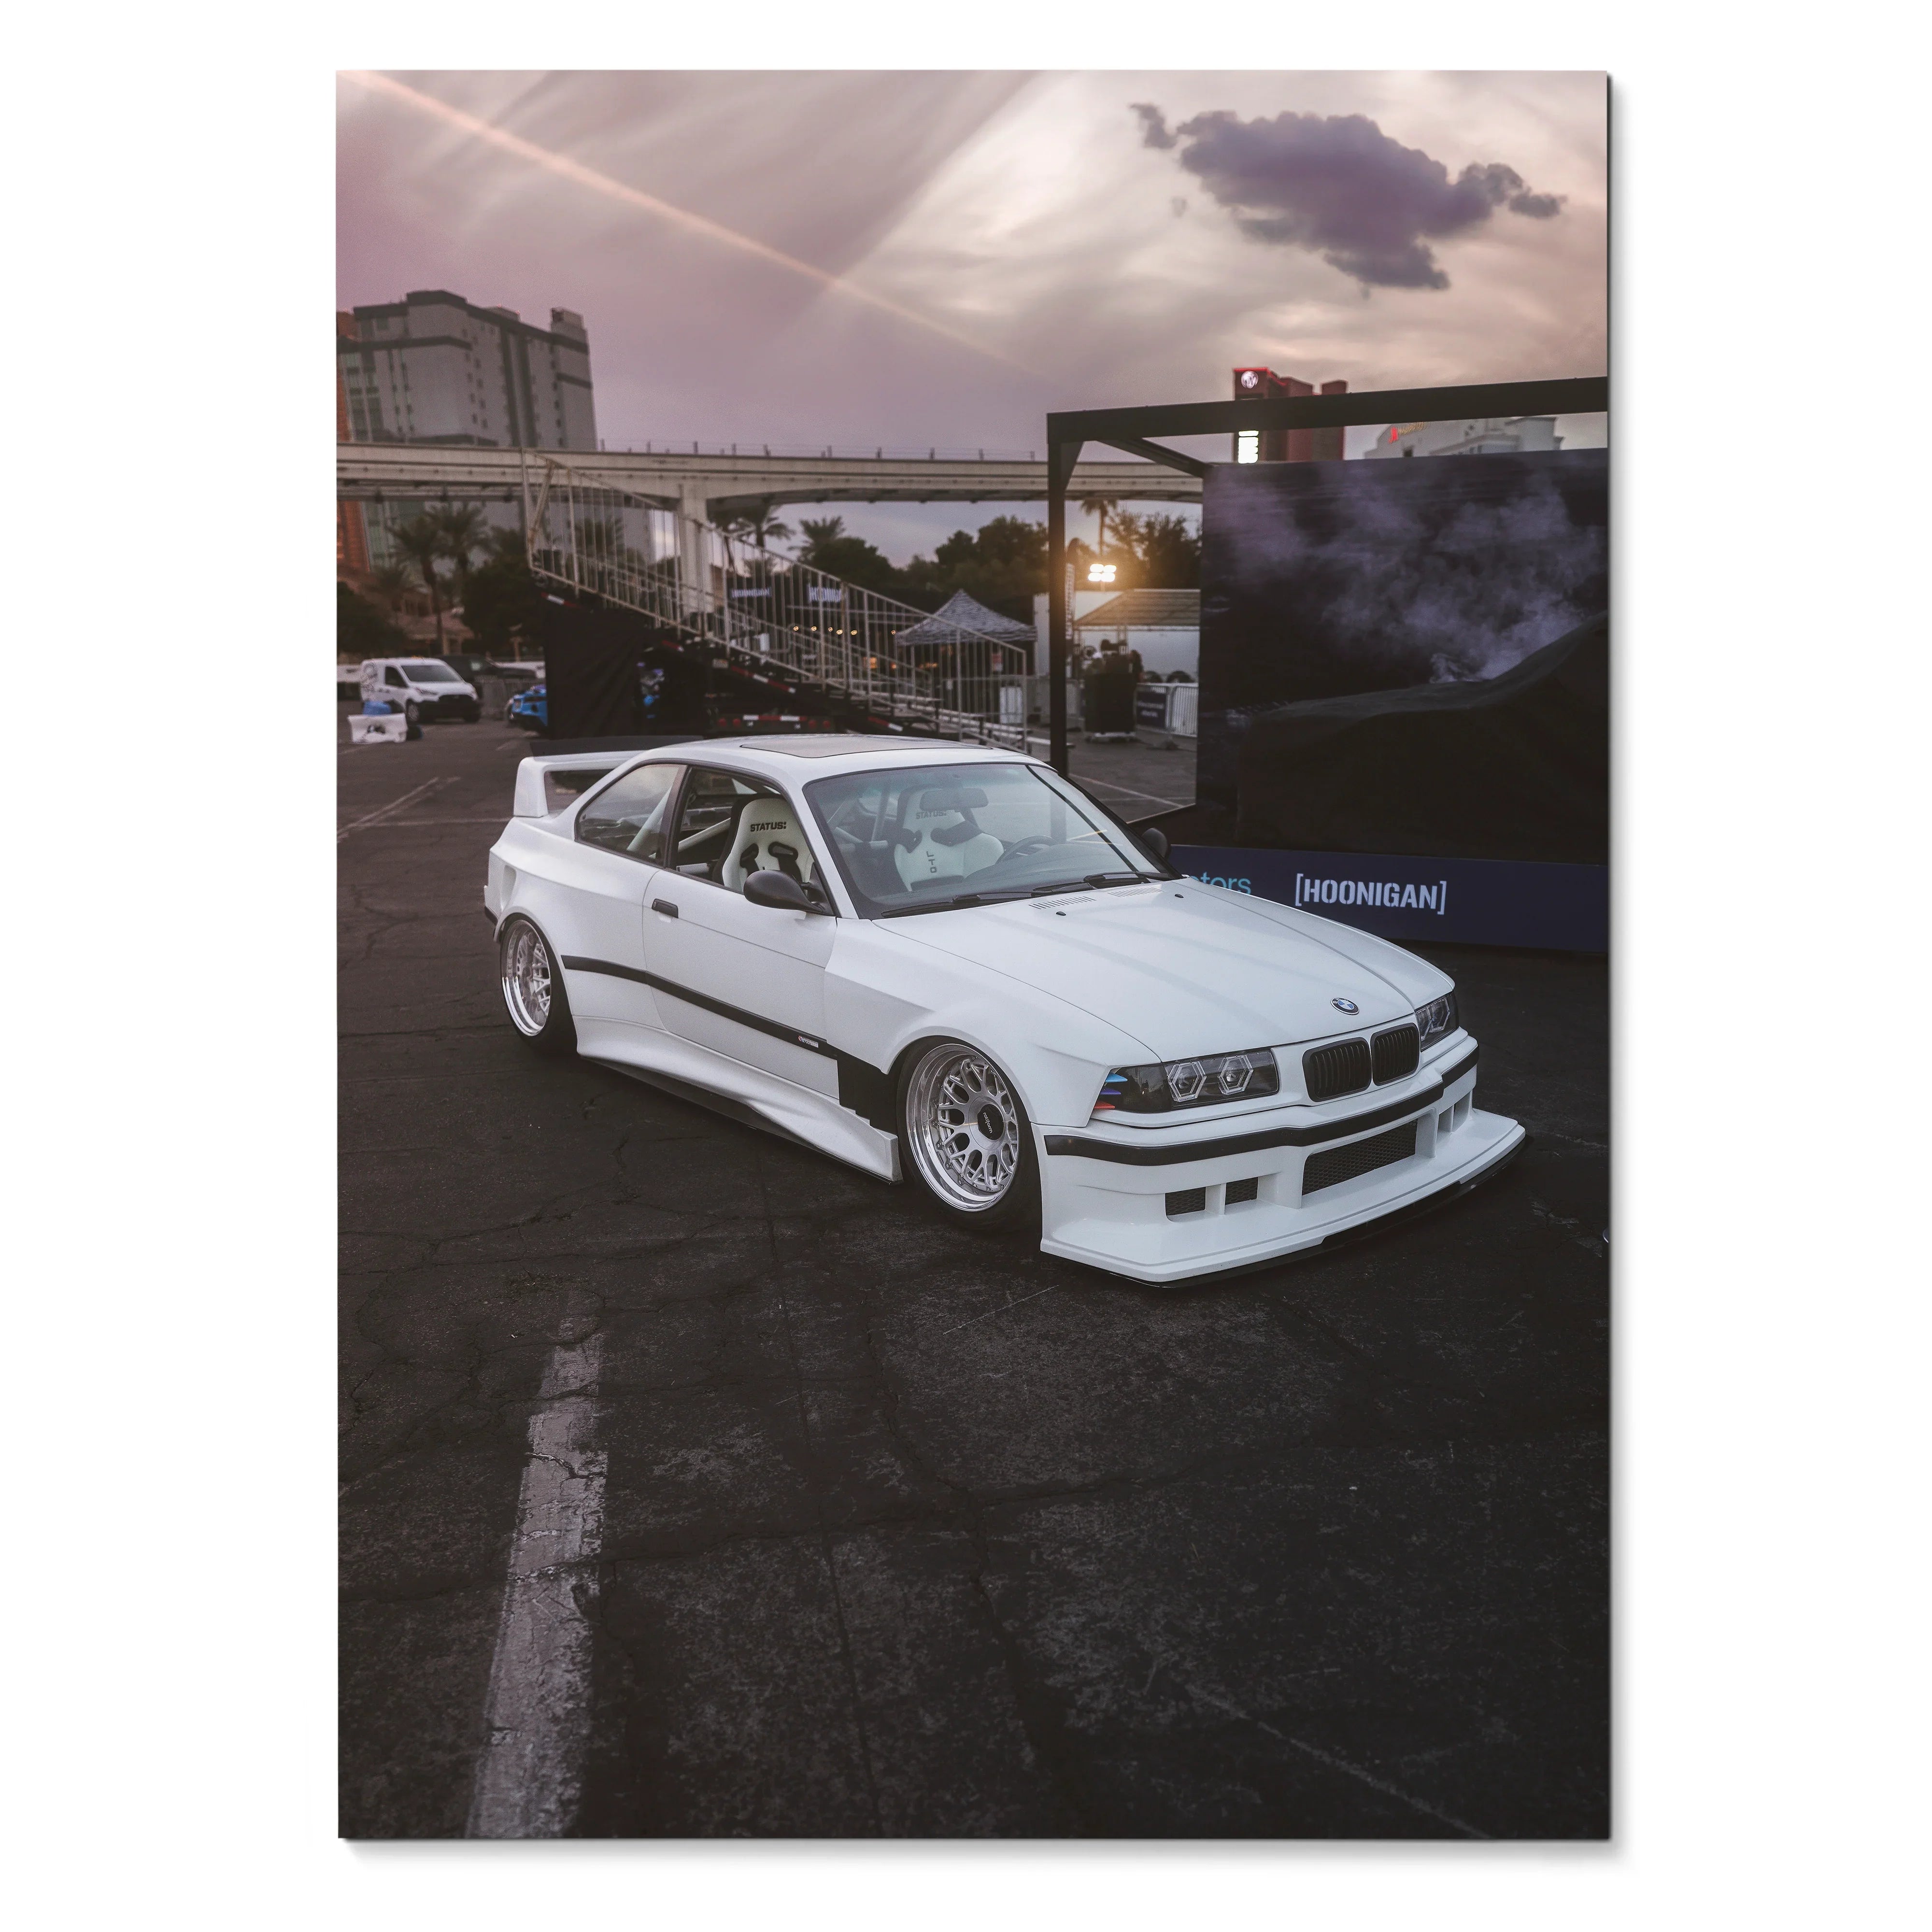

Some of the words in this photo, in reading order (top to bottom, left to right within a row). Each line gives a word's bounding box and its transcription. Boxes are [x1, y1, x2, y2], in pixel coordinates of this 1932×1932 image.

[750, 822, 787, 832] STATUS:
[1190, 871, 1251, 895] tors
[1295, 873, 1447, 915] [HOONIGAN]
[983, 1112, 993, 1134] rotiform
